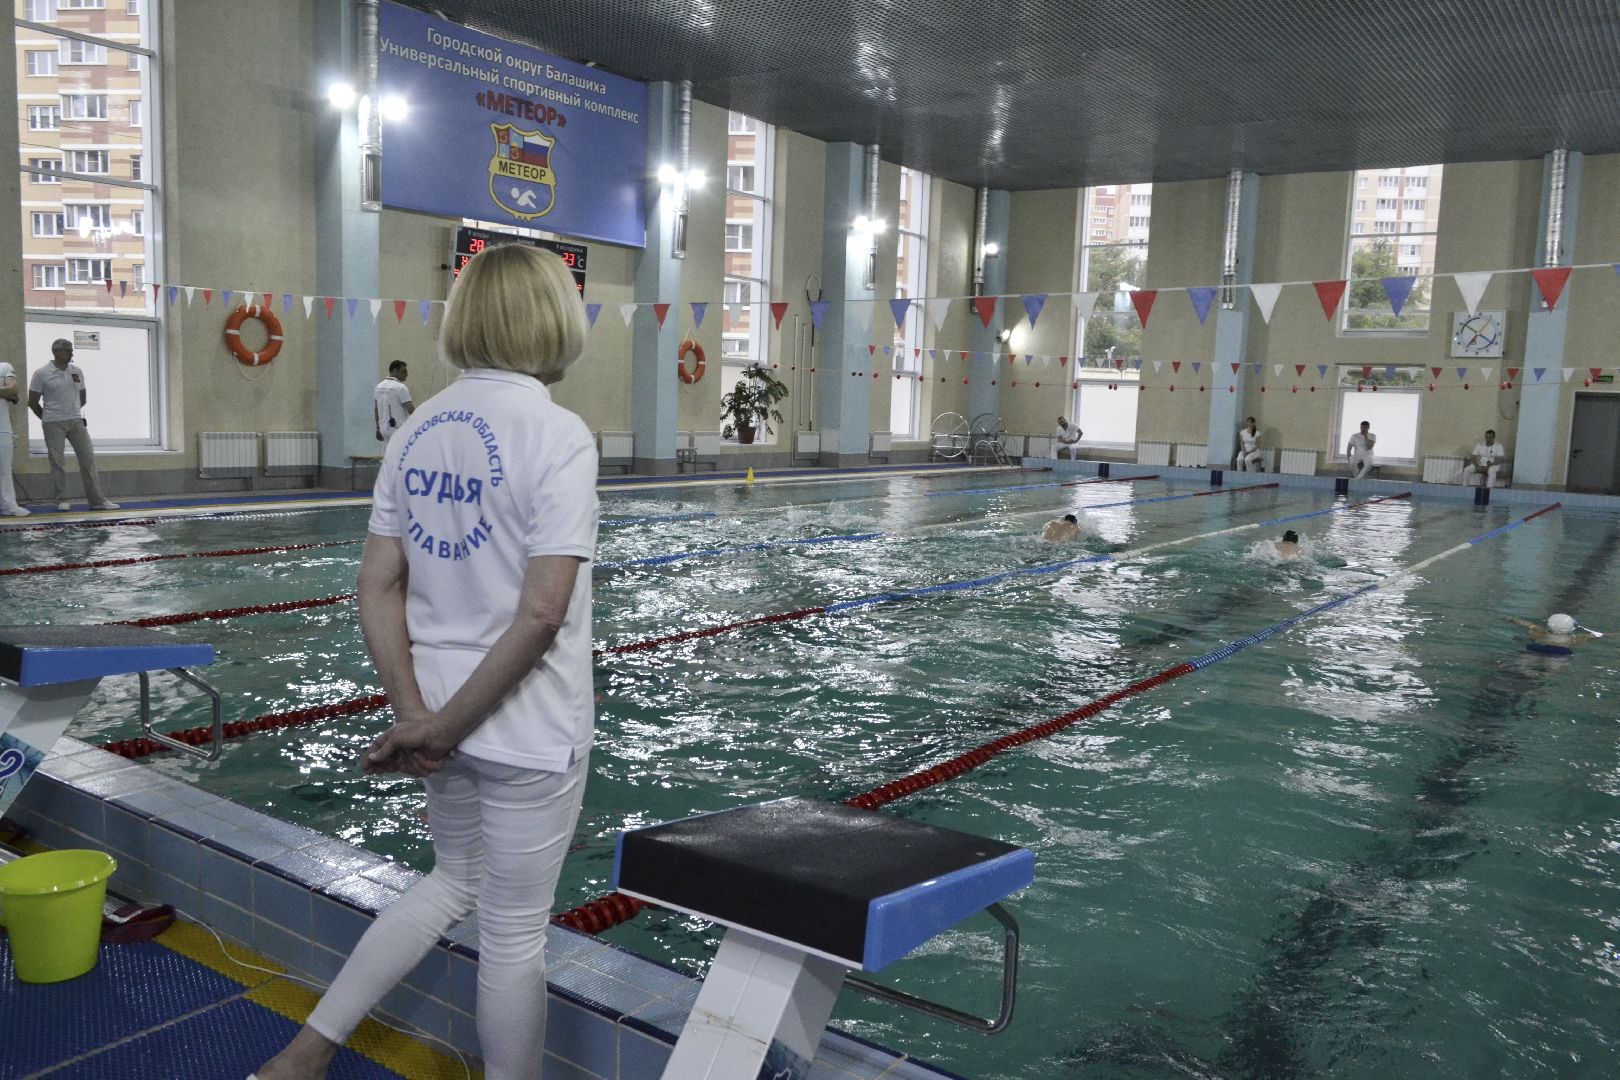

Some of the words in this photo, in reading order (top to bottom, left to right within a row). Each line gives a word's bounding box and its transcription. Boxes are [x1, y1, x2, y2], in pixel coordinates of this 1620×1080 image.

[380, 36, 500, 85] Универсальный
[503, 75, 581, 108] спортивный
[584, 99, 639, 124] комплекс
[427, 27, 503, 63] Городской
[505, 55, 542, 76] округ
[546, 64, 606, 95] Балашиха
[476, 90, 567, 128] «МЕТЕОР»
[499, 160, 546, 181] МЕТЕОР
[472, 417, 504, 487] ОБЛАСТЬ
[404, 467, 483, 505] СУДЬЯ
